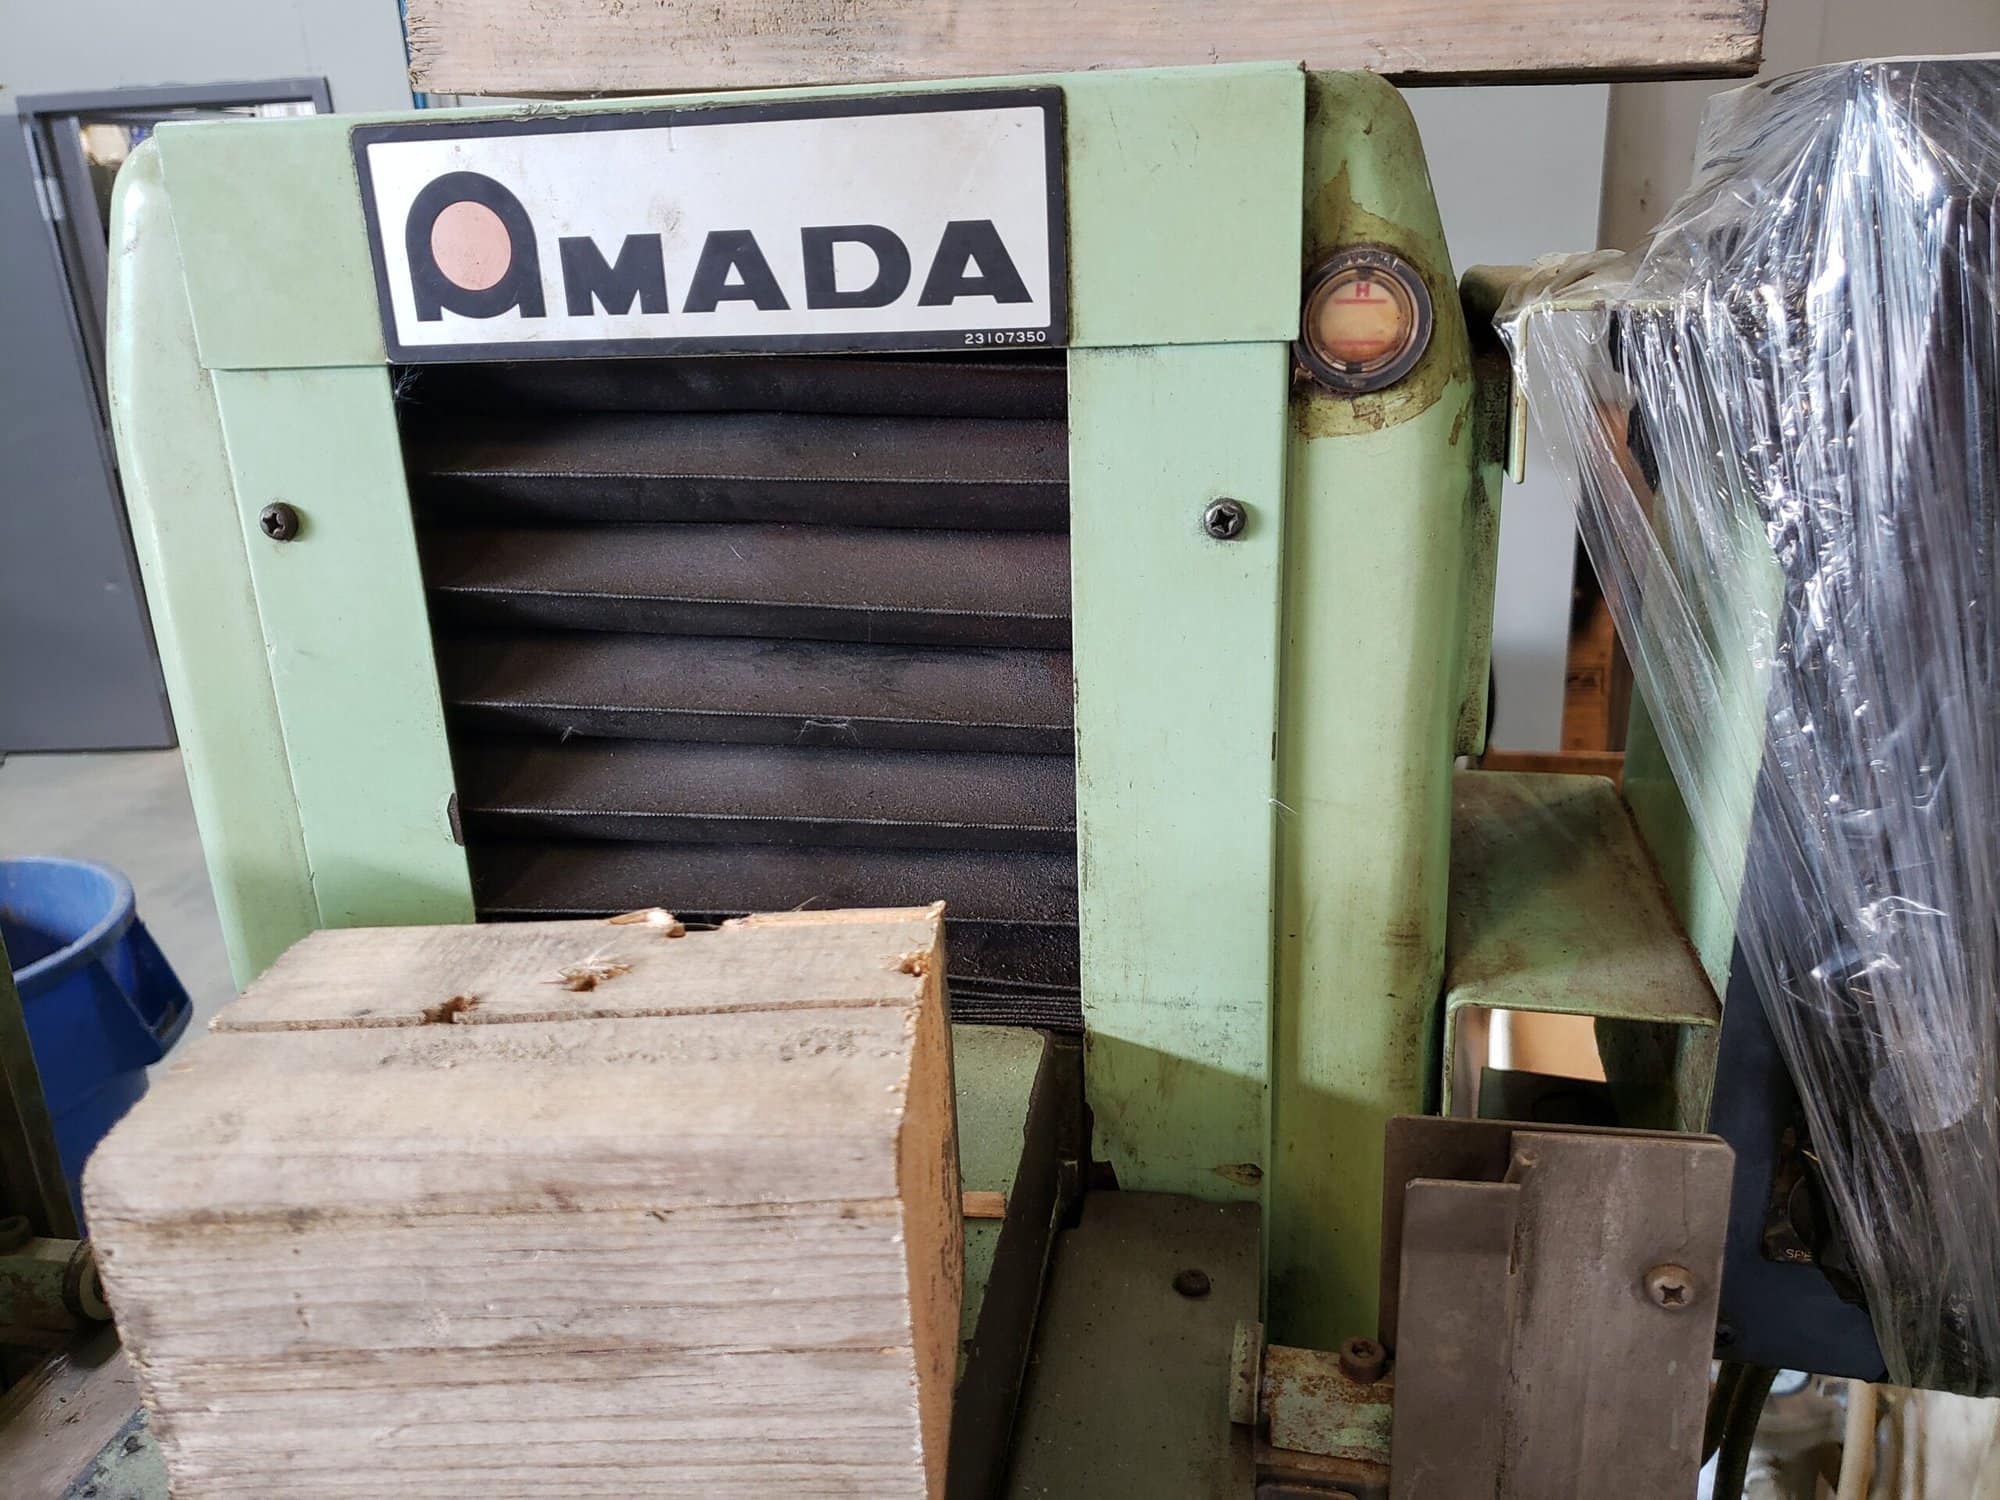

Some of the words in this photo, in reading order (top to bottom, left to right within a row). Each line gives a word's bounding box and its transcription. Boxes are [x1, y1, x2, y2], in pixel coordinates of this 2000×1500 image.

[405, 170, 1033, 322] AMADA
[1355, 282, 1371, 298] H
[964, 330, 1046, 345] 23107350
